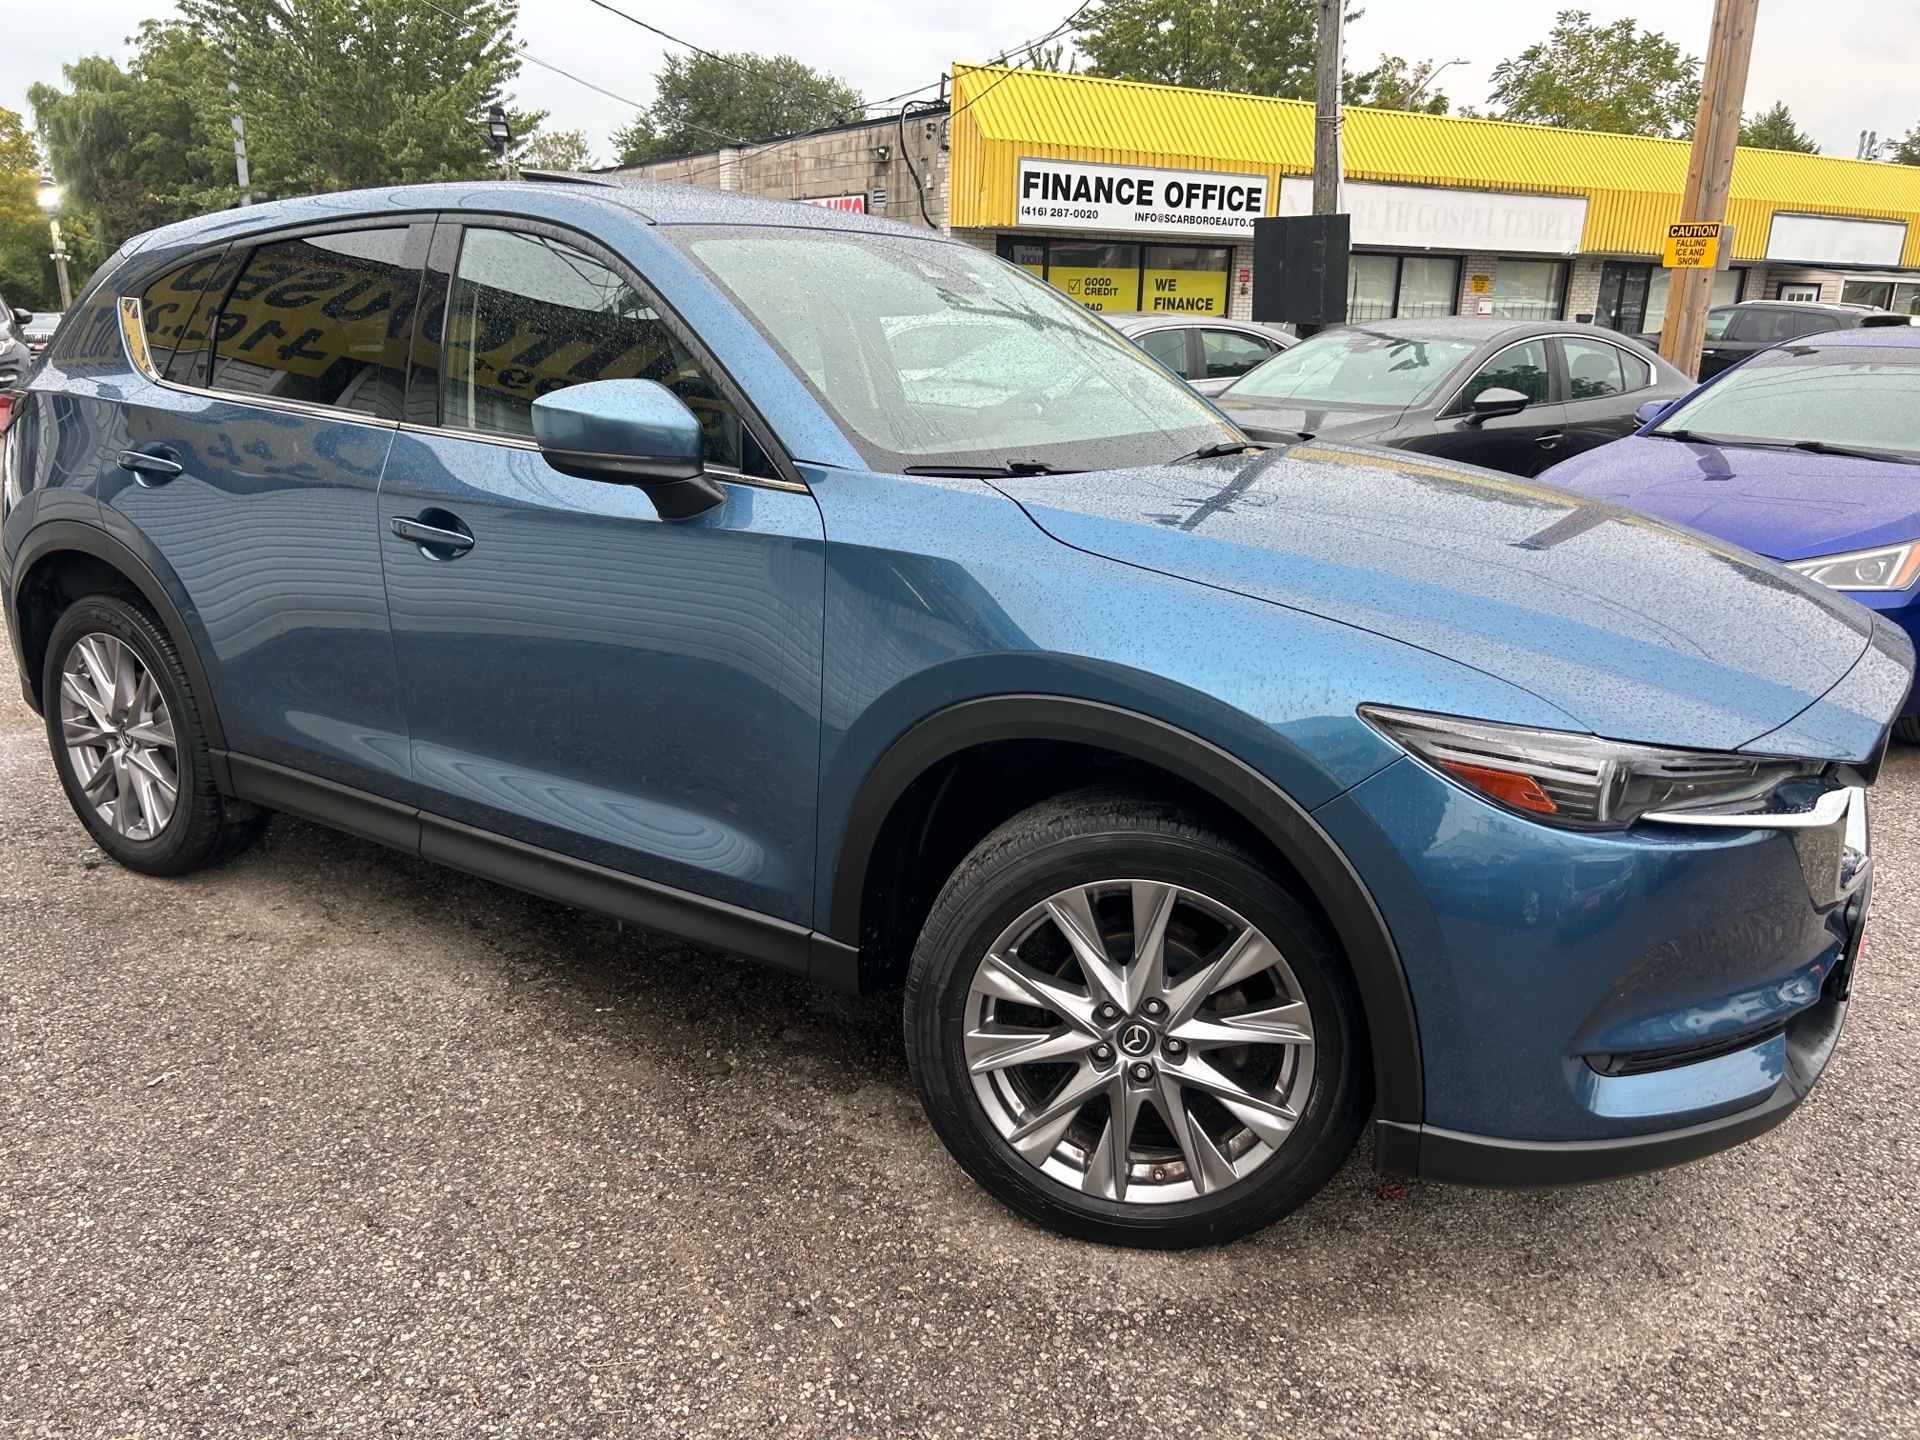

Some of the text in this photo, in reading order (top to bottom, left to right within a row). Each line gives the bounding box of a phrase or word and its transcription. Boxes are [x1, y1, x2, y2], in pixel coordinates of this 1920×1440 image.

[1023, 171, 1262, 212] FINANCE OFFICE
[1021, 206, 1099, 219] (416) 287-0020
[1416, 203, 1497, 237] GOSPEL
[1503, 208, 1580, 240] TEMPLE
[1670, 225, 1717, 237] CAUTION
[1676, 239, 1707, 247] FALLING
[1675, 248, 1705, 256] ICE AND
[1677, 257, 1700, 265] SNOW
[1084, 277, 1112, 286] GOOD
[1155, 279, 1177, 291] WE
[1084, 287, 1118, 296] CREDIT
[1153, 297, 1214, 311] FINANCE
